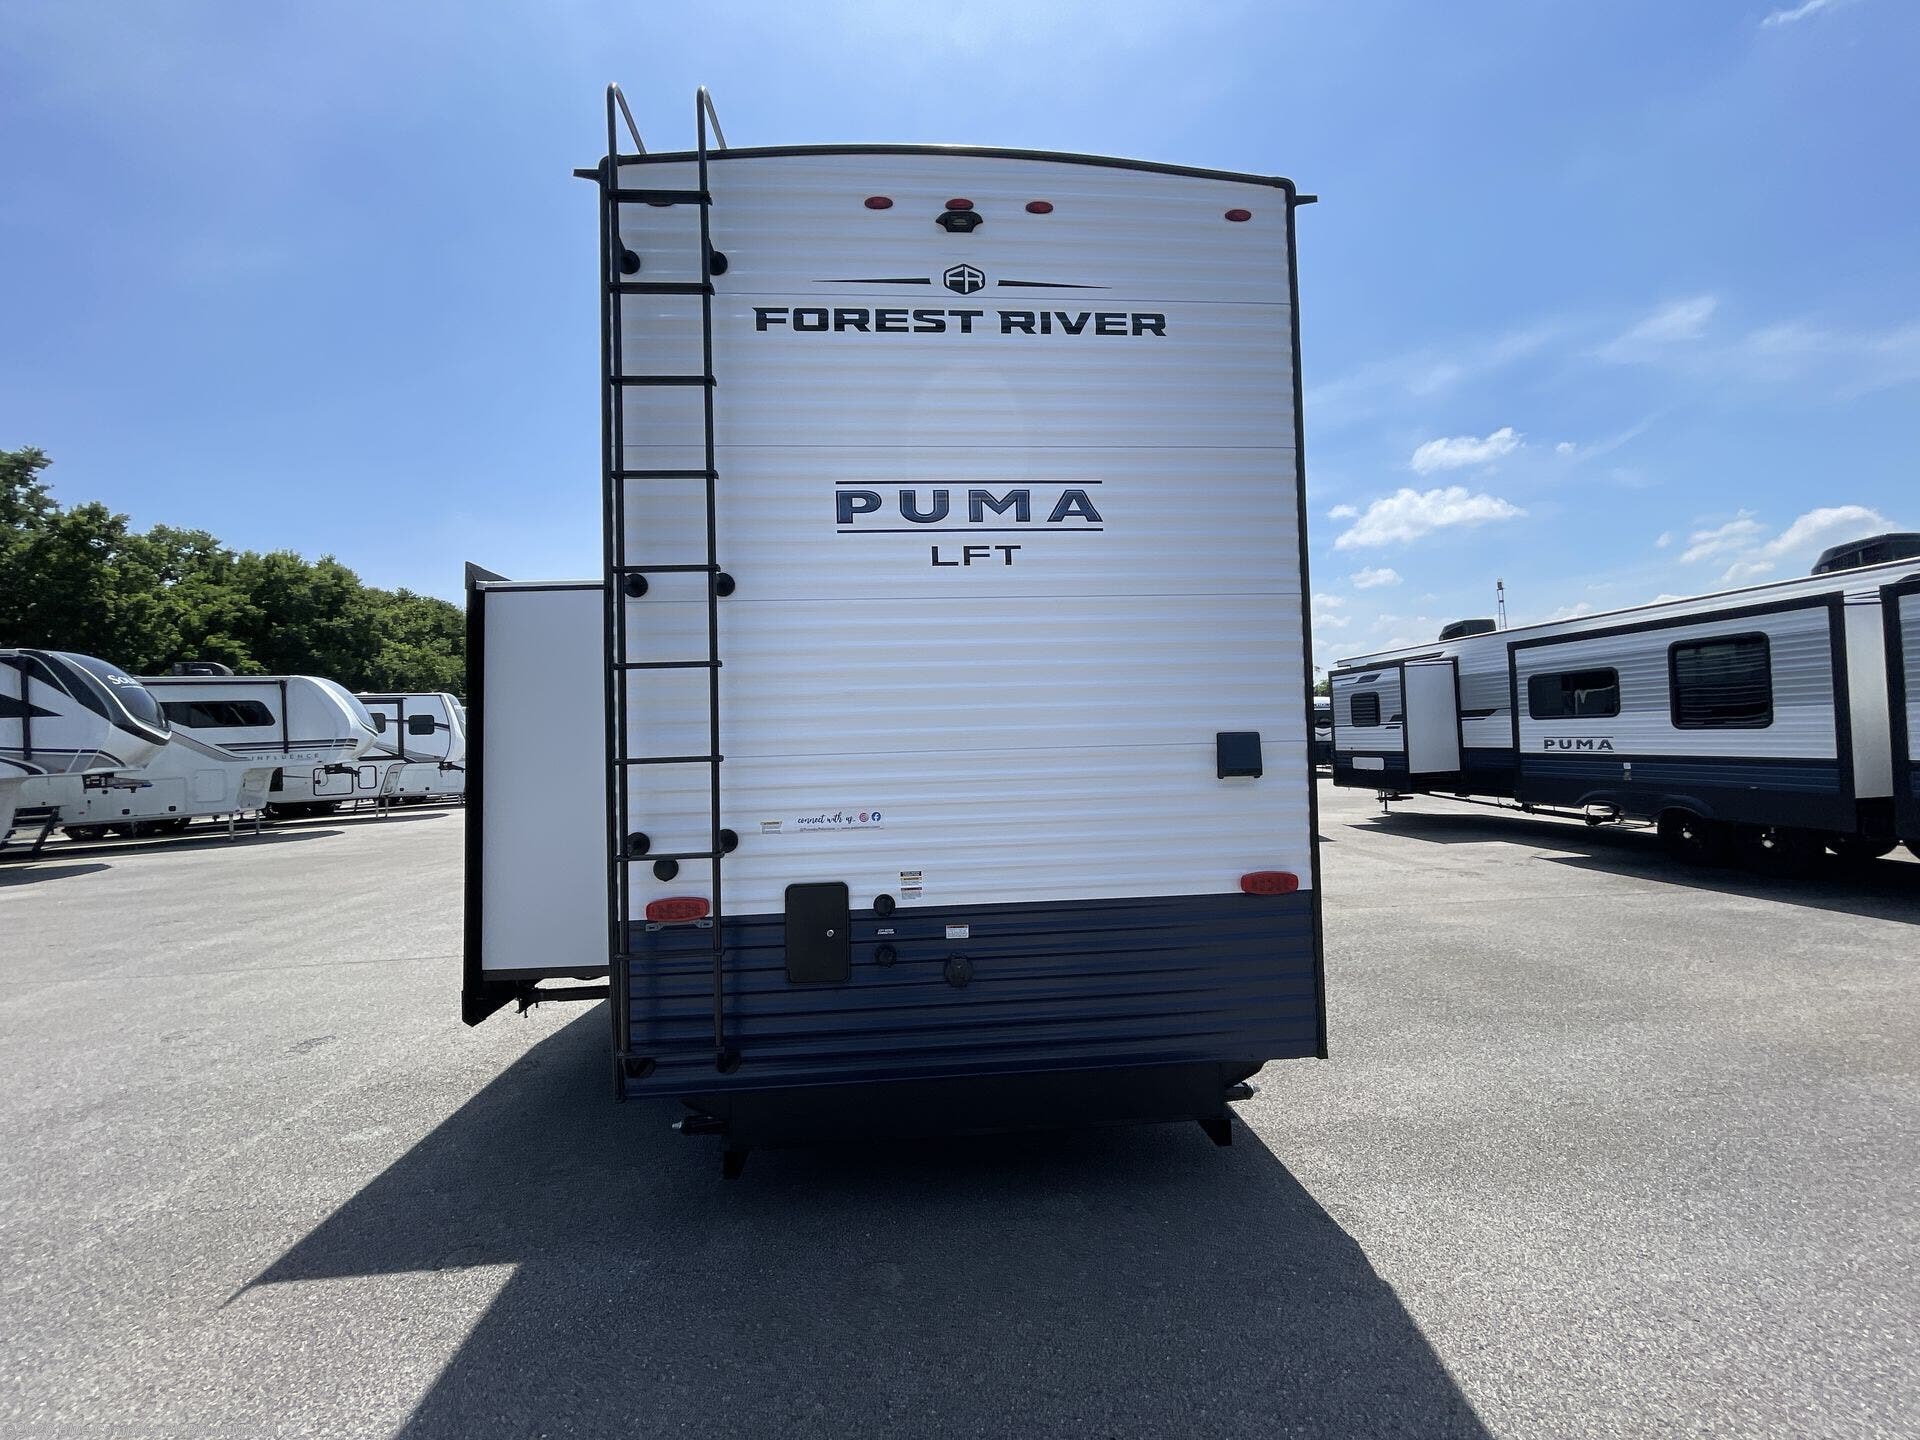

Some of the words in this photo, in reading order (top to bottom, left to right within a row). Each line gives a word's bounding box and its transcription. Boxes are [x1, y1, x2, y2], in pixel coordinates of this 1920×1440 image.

[752, 307, 984, 333] FOREST
[996, 310, 1168, 337] RIVER
[835, 489, 1104, 524] PUMA
[931, 545, 1022, 566] LFT
[1543, 738, 1614, 751] PUMA
[251, 753, 320, 761] INFLUENCE
[797, 814, 825, 825] connect
[826, 811, 842, 824] with
